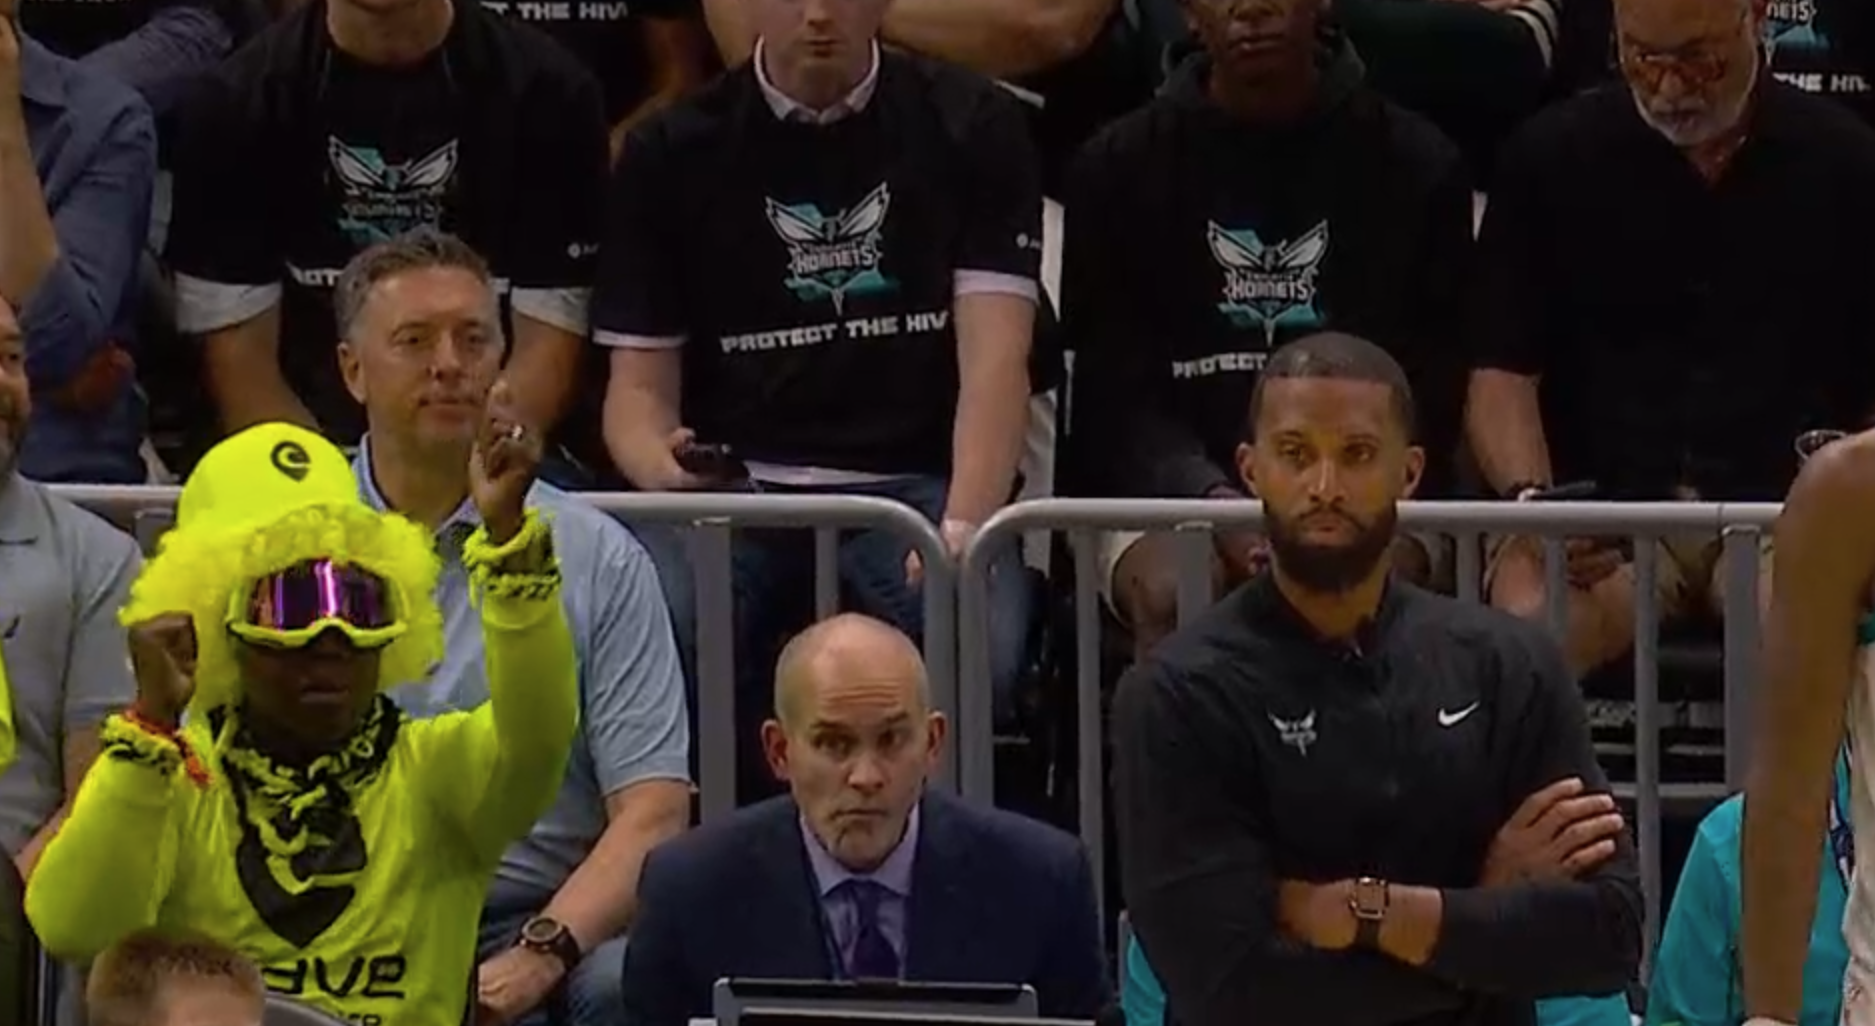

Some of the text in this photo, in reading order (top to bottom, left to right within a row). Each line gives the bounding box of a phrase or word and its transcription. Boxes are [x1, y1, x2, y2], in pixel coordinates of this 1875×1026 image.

[517, 2, 570, 20] THE
[720, 321, 838, 353] PROTECT
[845, 314, 899, 338] THE
